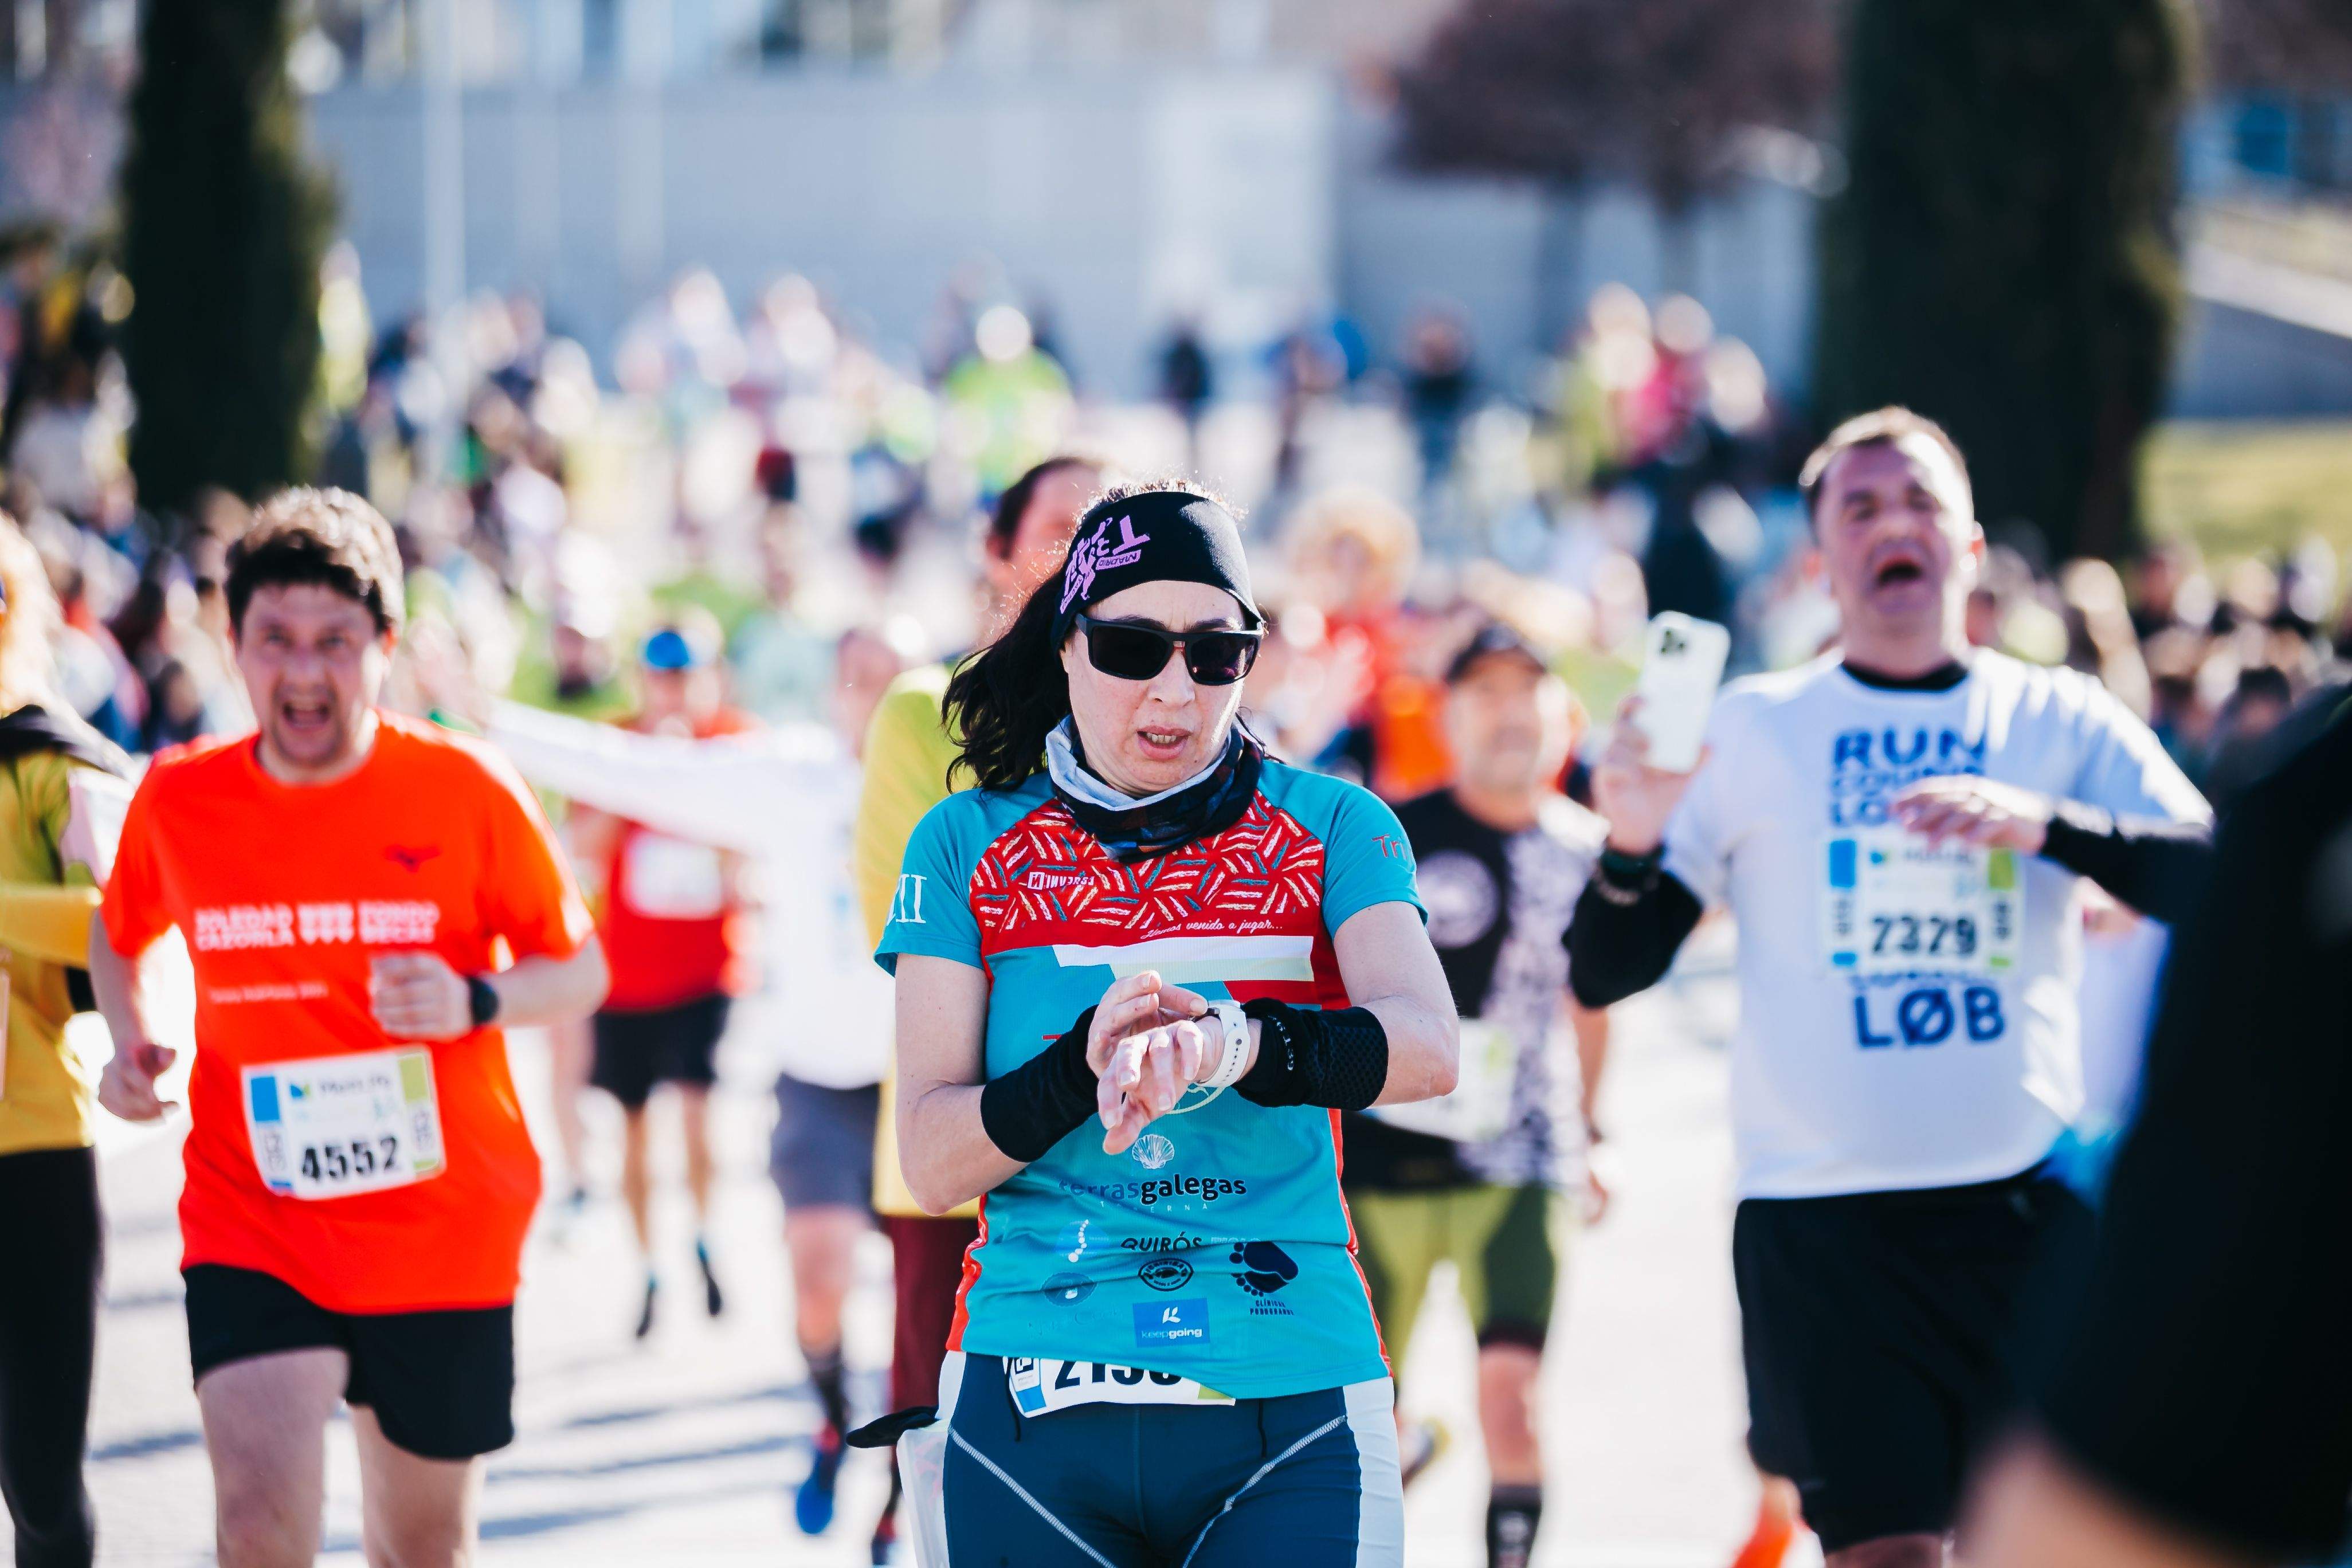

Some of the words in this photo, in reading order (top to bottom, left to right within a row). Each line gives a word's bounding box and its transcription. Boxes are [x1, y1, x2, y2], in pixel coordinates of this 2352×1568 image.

[1098, 552, 1138, 567] MADRID
[1833, 728, 1985, 769] RUN
[1140, 923, 1182, 939] Hemos
[1186, 918, 1225, 930] venido
[1242, 919, 1288, 934] jugar...
[1855, 986, 2006, 1049] LØB
[301, 1134, 399, 1181] 4552
[1059, 1174, 1248, 1206] terrasgalegas
[1142, 1327, 1202, 1339] keepgoing
